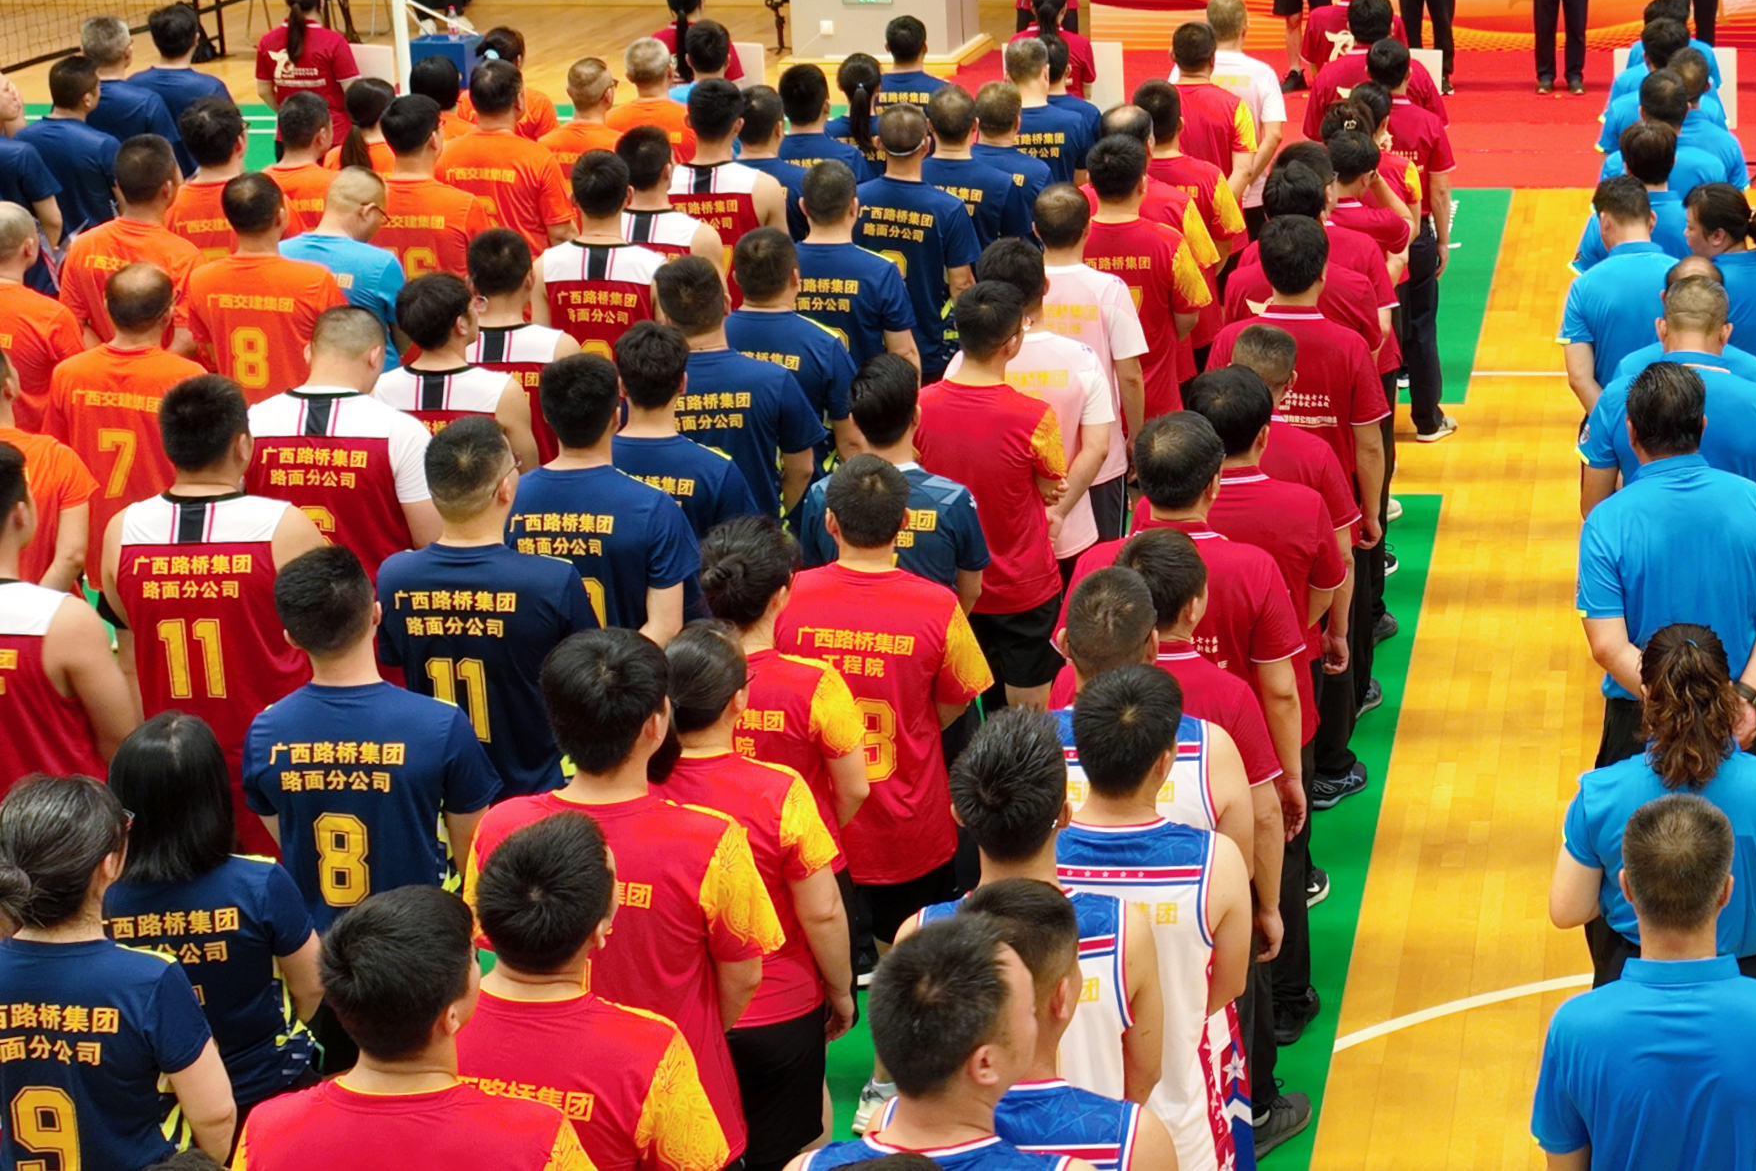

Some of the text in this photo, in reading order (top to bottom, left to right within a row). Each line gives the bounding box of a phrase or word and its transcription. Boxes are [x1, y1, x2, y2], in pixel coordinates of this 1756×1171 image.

[858, 205, 934, 228] 广西路桥集团
[863, 223, 925, 243] 路面分公司
[334, 274, 354, 289] 团
[798, 278, 859, 295] 路桥集团
[207, 293, 295, 313] 广西交建集团
[557, 290, 638, 308] 广西路桥集团
[792, 297, 850, 313] 面分公司
[229, 327, 269, 390] 8
[71, 389, 162, 412] 广西交建集团
[97, 429, 137, 499] 7
[261, 446, 368, 468] 广西路桥集团
[269, 468, 356, 489] 路面分公司
[510, 513, 614, 535] 广西路桥集团
[517, 537, 603, 557] 路面分公司
[132, 553, 252, 575] 广西路桥集团
[142, 580, 240, 599] 路面分公司
[394, 590, 517, 614] 广西路桥集团
[406, 616, 504, 638] 路面分公司
[797, 625, 915, 656] 广西路桥集团
[157, 618, 227, 699] 11
[822, 654, 886, 678] 工程院
[426, 657, 491, 744] 11
[270, 742, 405, 766] 广西路桥集团
[280, 771, 391, 793] 路面分公司
[313, 812, 370, 907] 8
[10, 1085, 82, 1171] 9
